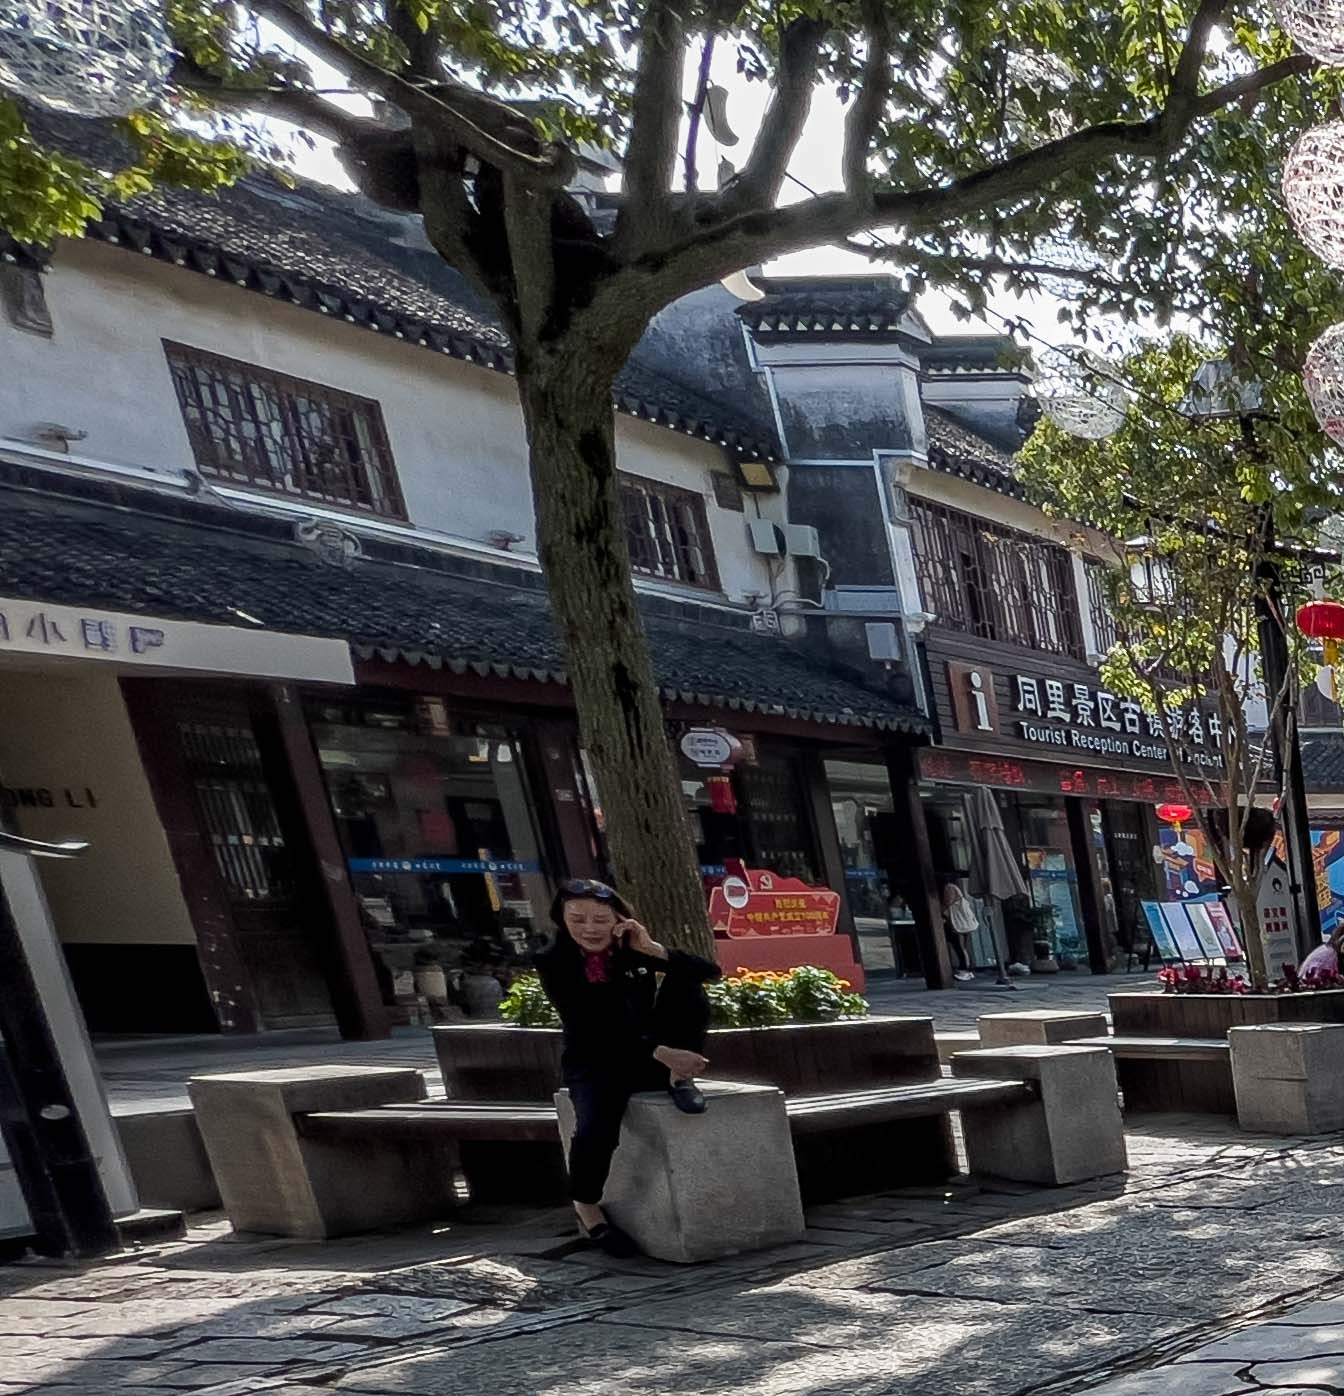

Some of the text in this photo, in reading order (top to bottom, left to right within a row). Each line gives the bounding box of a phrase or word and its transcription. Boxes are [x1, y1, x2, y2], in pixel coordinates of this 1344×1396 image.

[1019, 721, 1066, 745] Tourist
[1072, 728, 1129, 756] Reception
[1132, 740, 1168, 761] Center
